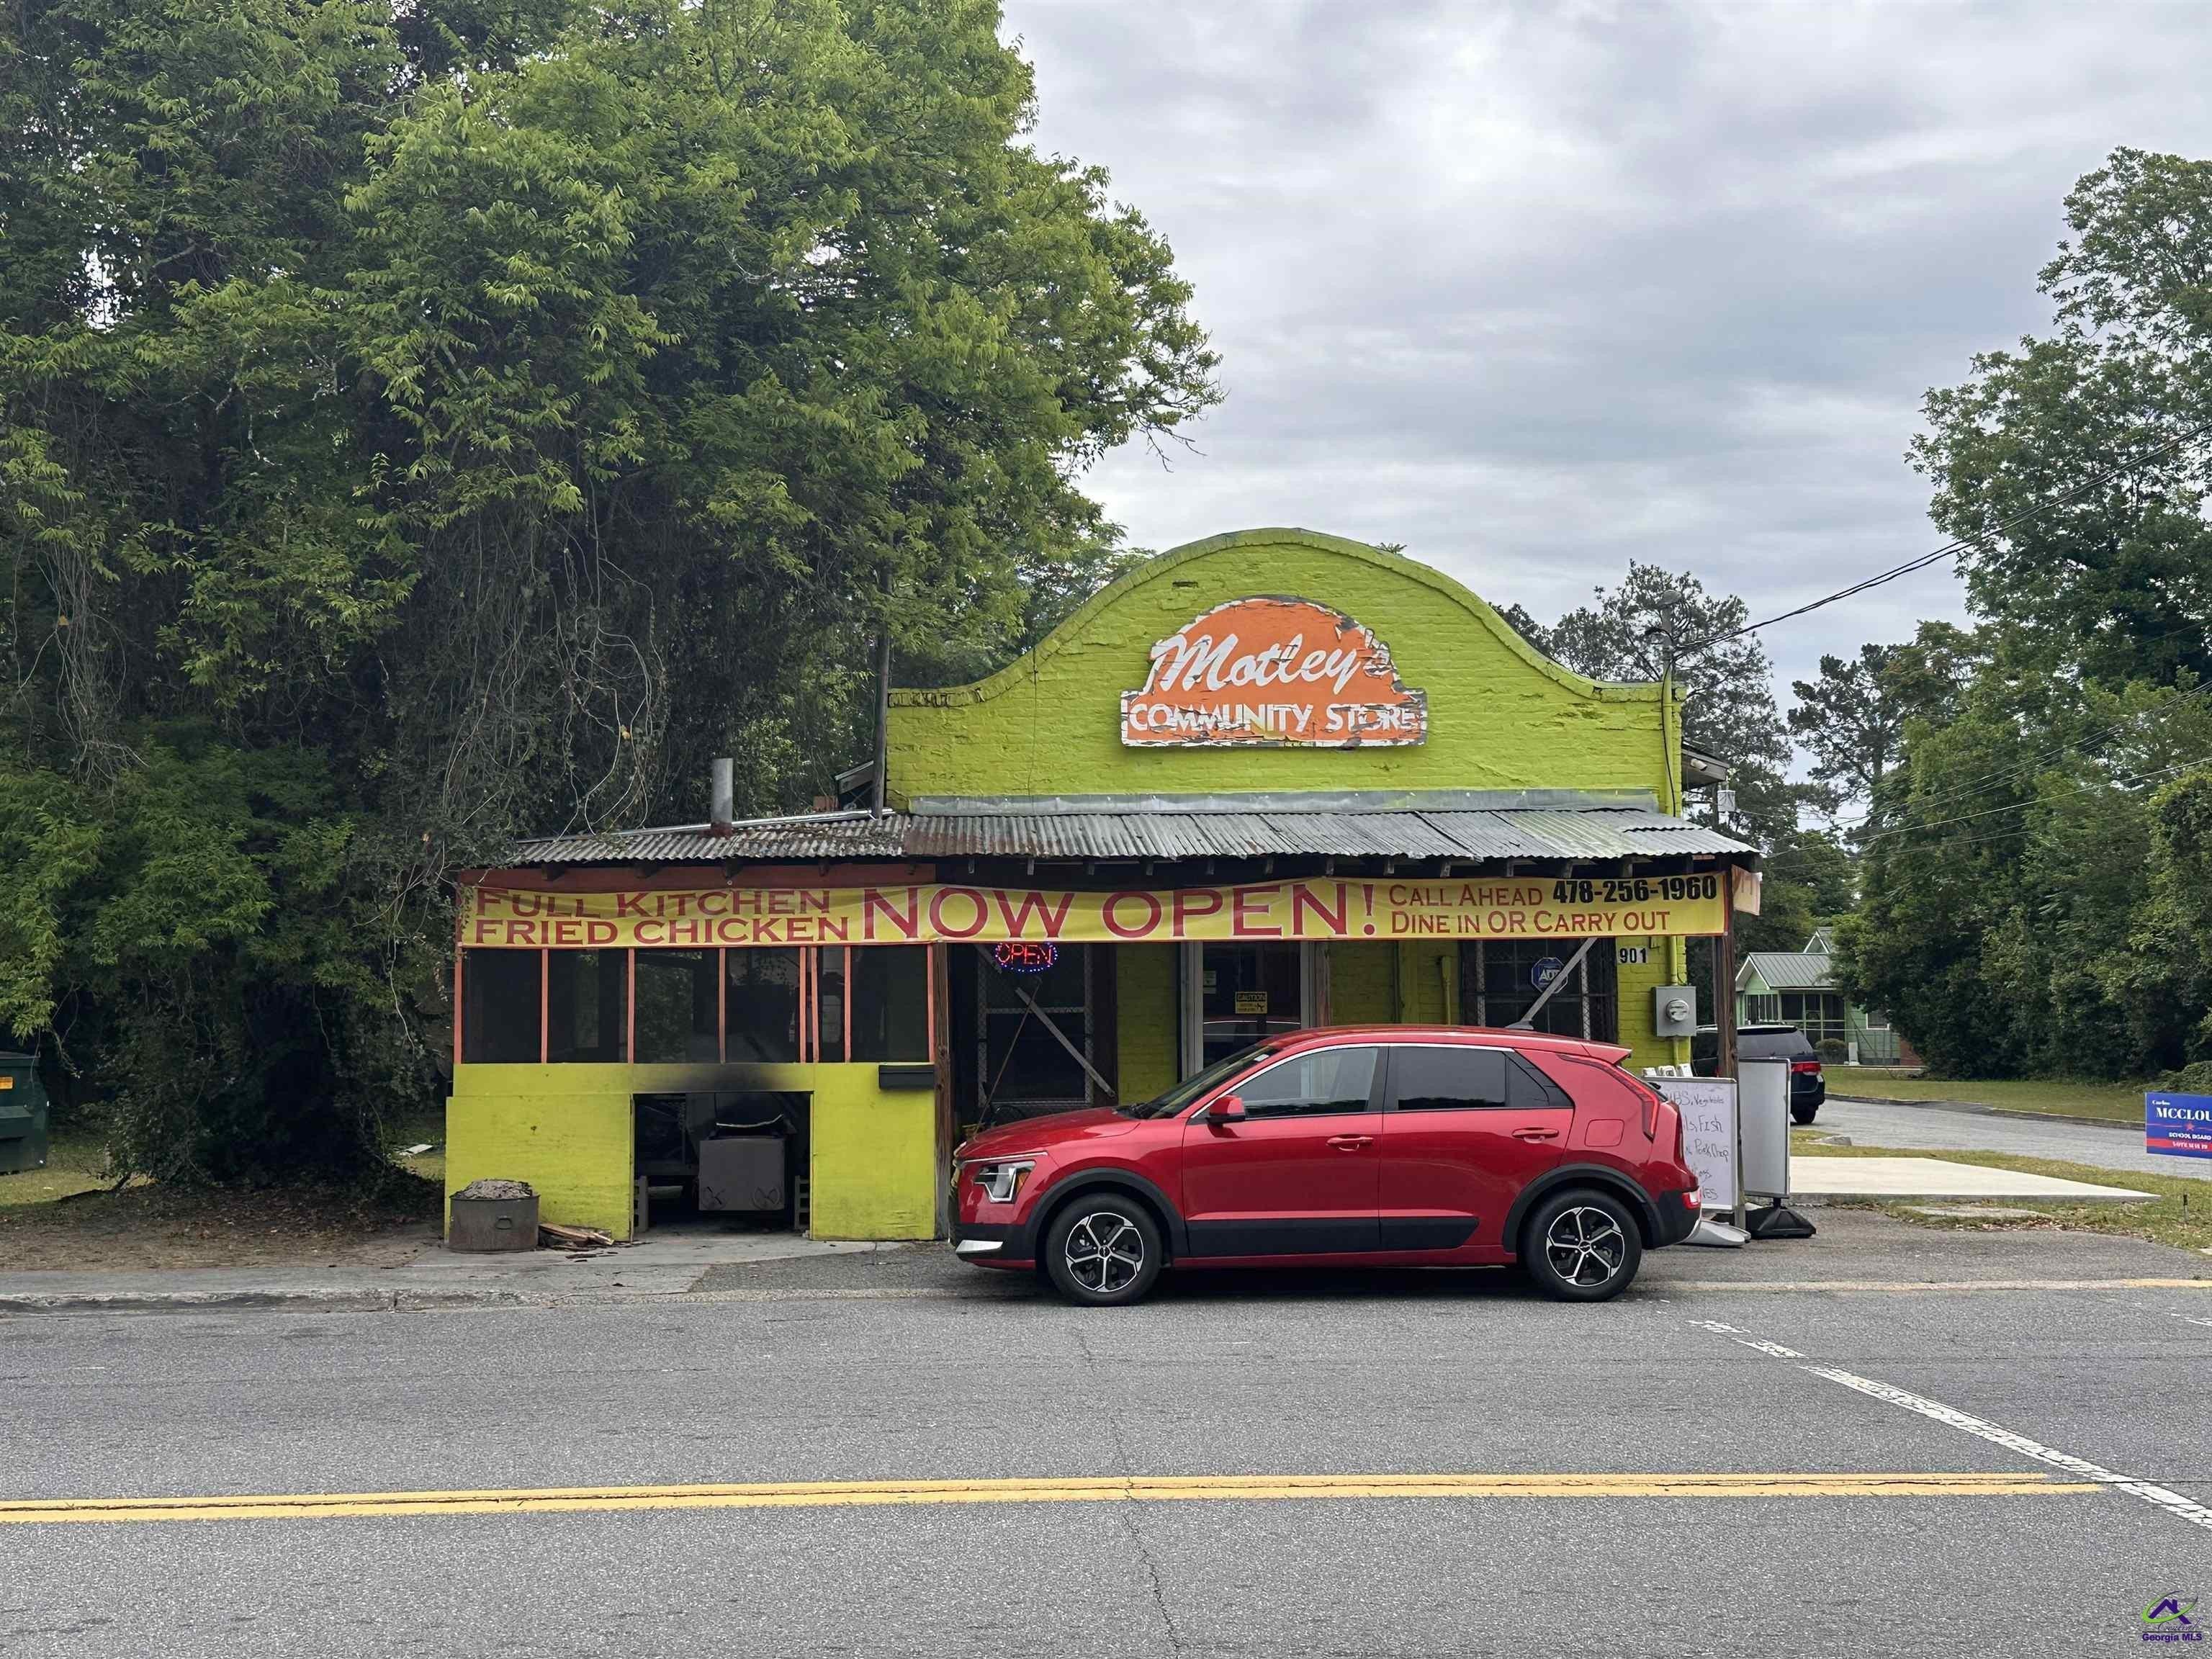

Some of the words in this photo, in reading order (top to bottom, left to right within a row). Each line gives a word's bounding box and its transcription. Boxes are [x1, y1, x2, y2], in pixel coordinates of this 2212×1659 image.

[1128, 703, 1314, 732] COMMUNITY
[1326, 703, 1418, 732] STORE
[476, 887, 601, 919] FULL
[616, 889, 831, 919] KITCHEN
[1388, 884, 1453, 907] CALL
[1458, 884, 1543, 907] AHEAD
[1552, 874, 1717, 904] 478-256-1960
[864, 886, 1076, 939] NOW
[1101, 882, 1376, 938] OPEN!
[1391, 910, 1449, 933] DINE
[1457, 914, 1480, 933] IN
[1488, 910, 1527, 933] OR
[1534, 910, 1618, 933] CARRY
[1623, 910, 1671, 932] OUT
[475, 920, 619, 945] FRIED
[633, 916, 849, 945] CHICKEN
[998, 943, 1052, 965] OPEN
[1620, 948, 1647, 963] 901
